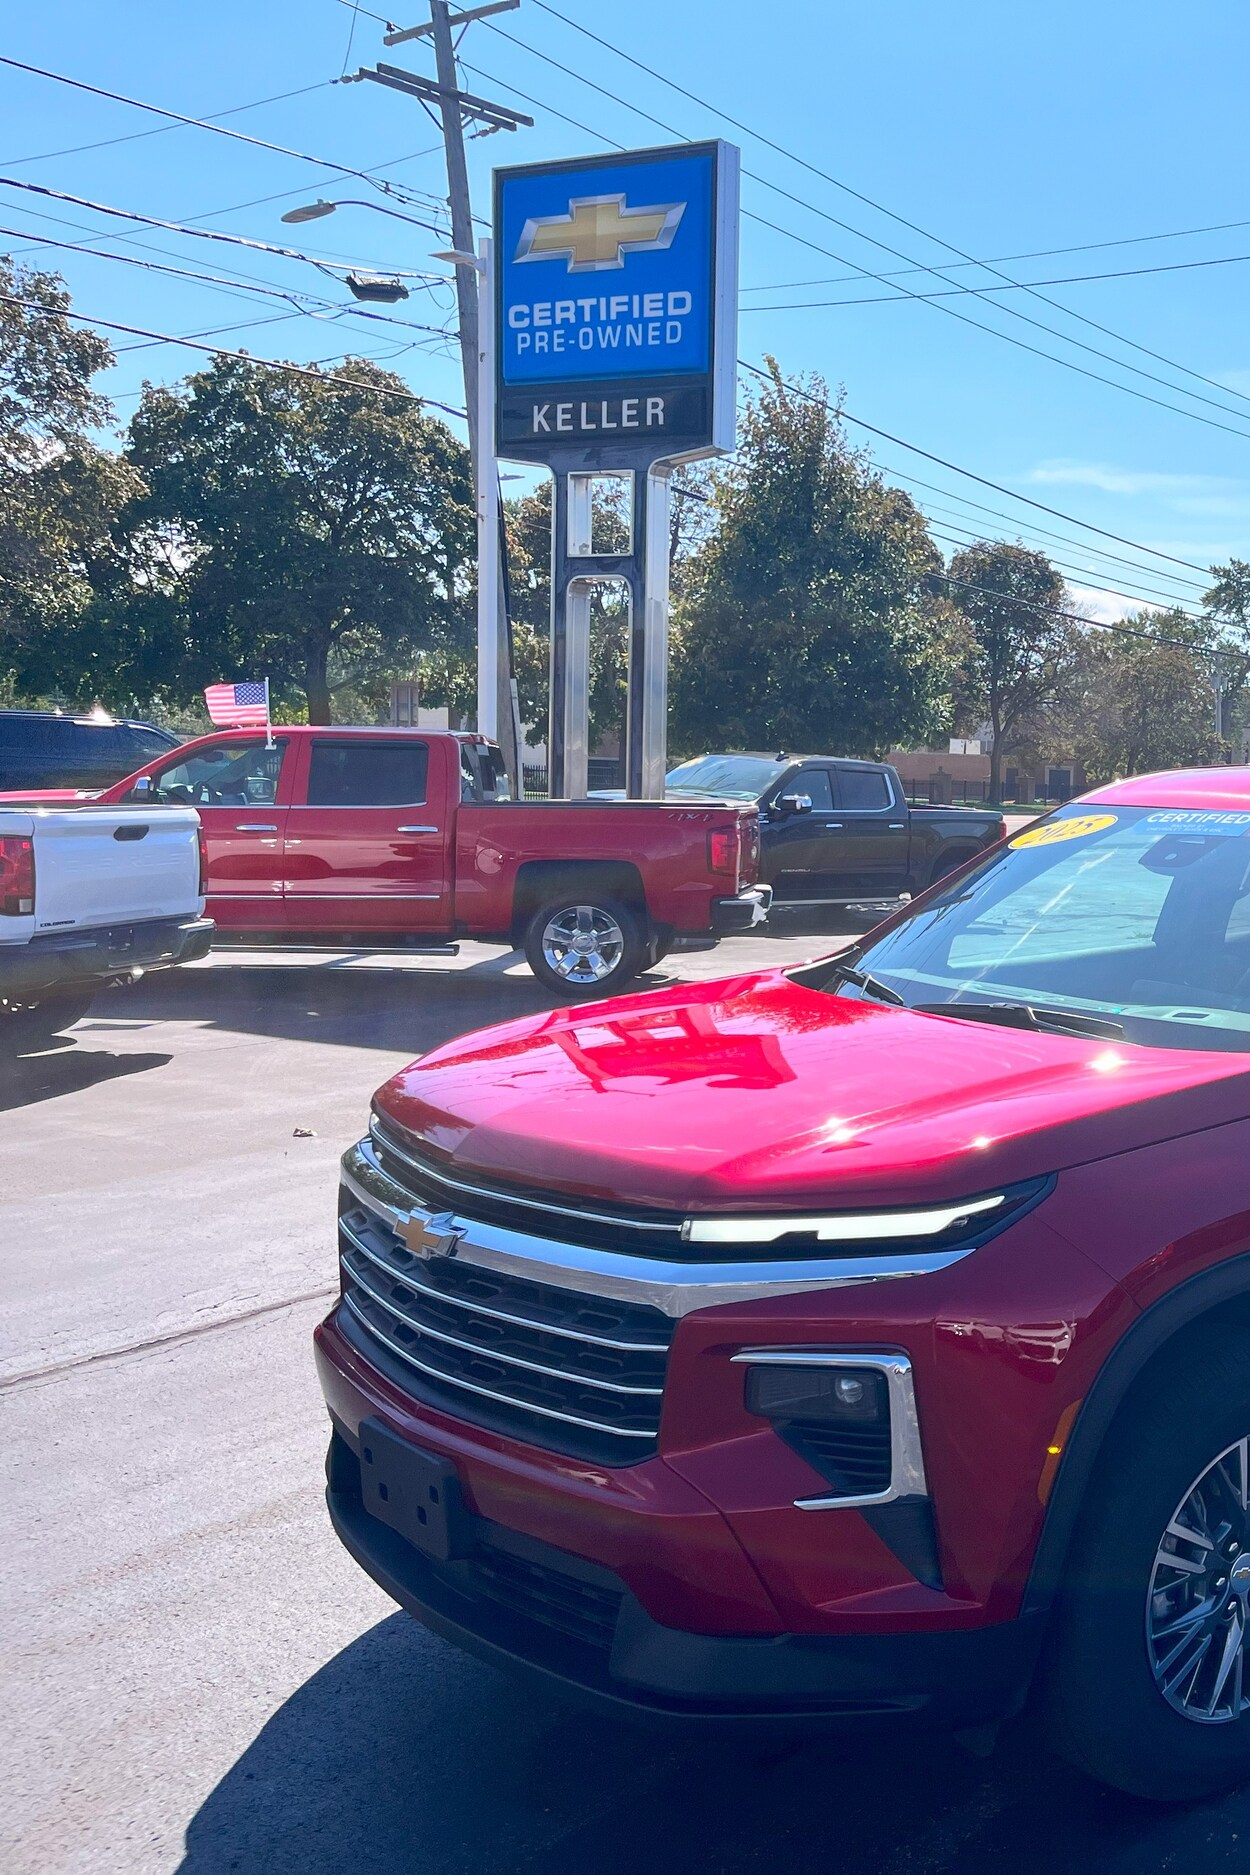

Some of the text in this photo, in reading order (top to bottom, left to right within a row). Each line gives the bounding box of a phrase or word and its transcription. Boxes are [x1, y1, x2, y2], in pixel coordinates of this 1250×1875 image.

[508, 290, 692, 329] CERTIFIED
[516, 320, 682, 355] PRE-OWNED
[532, 397, 665, 433] KELLER
